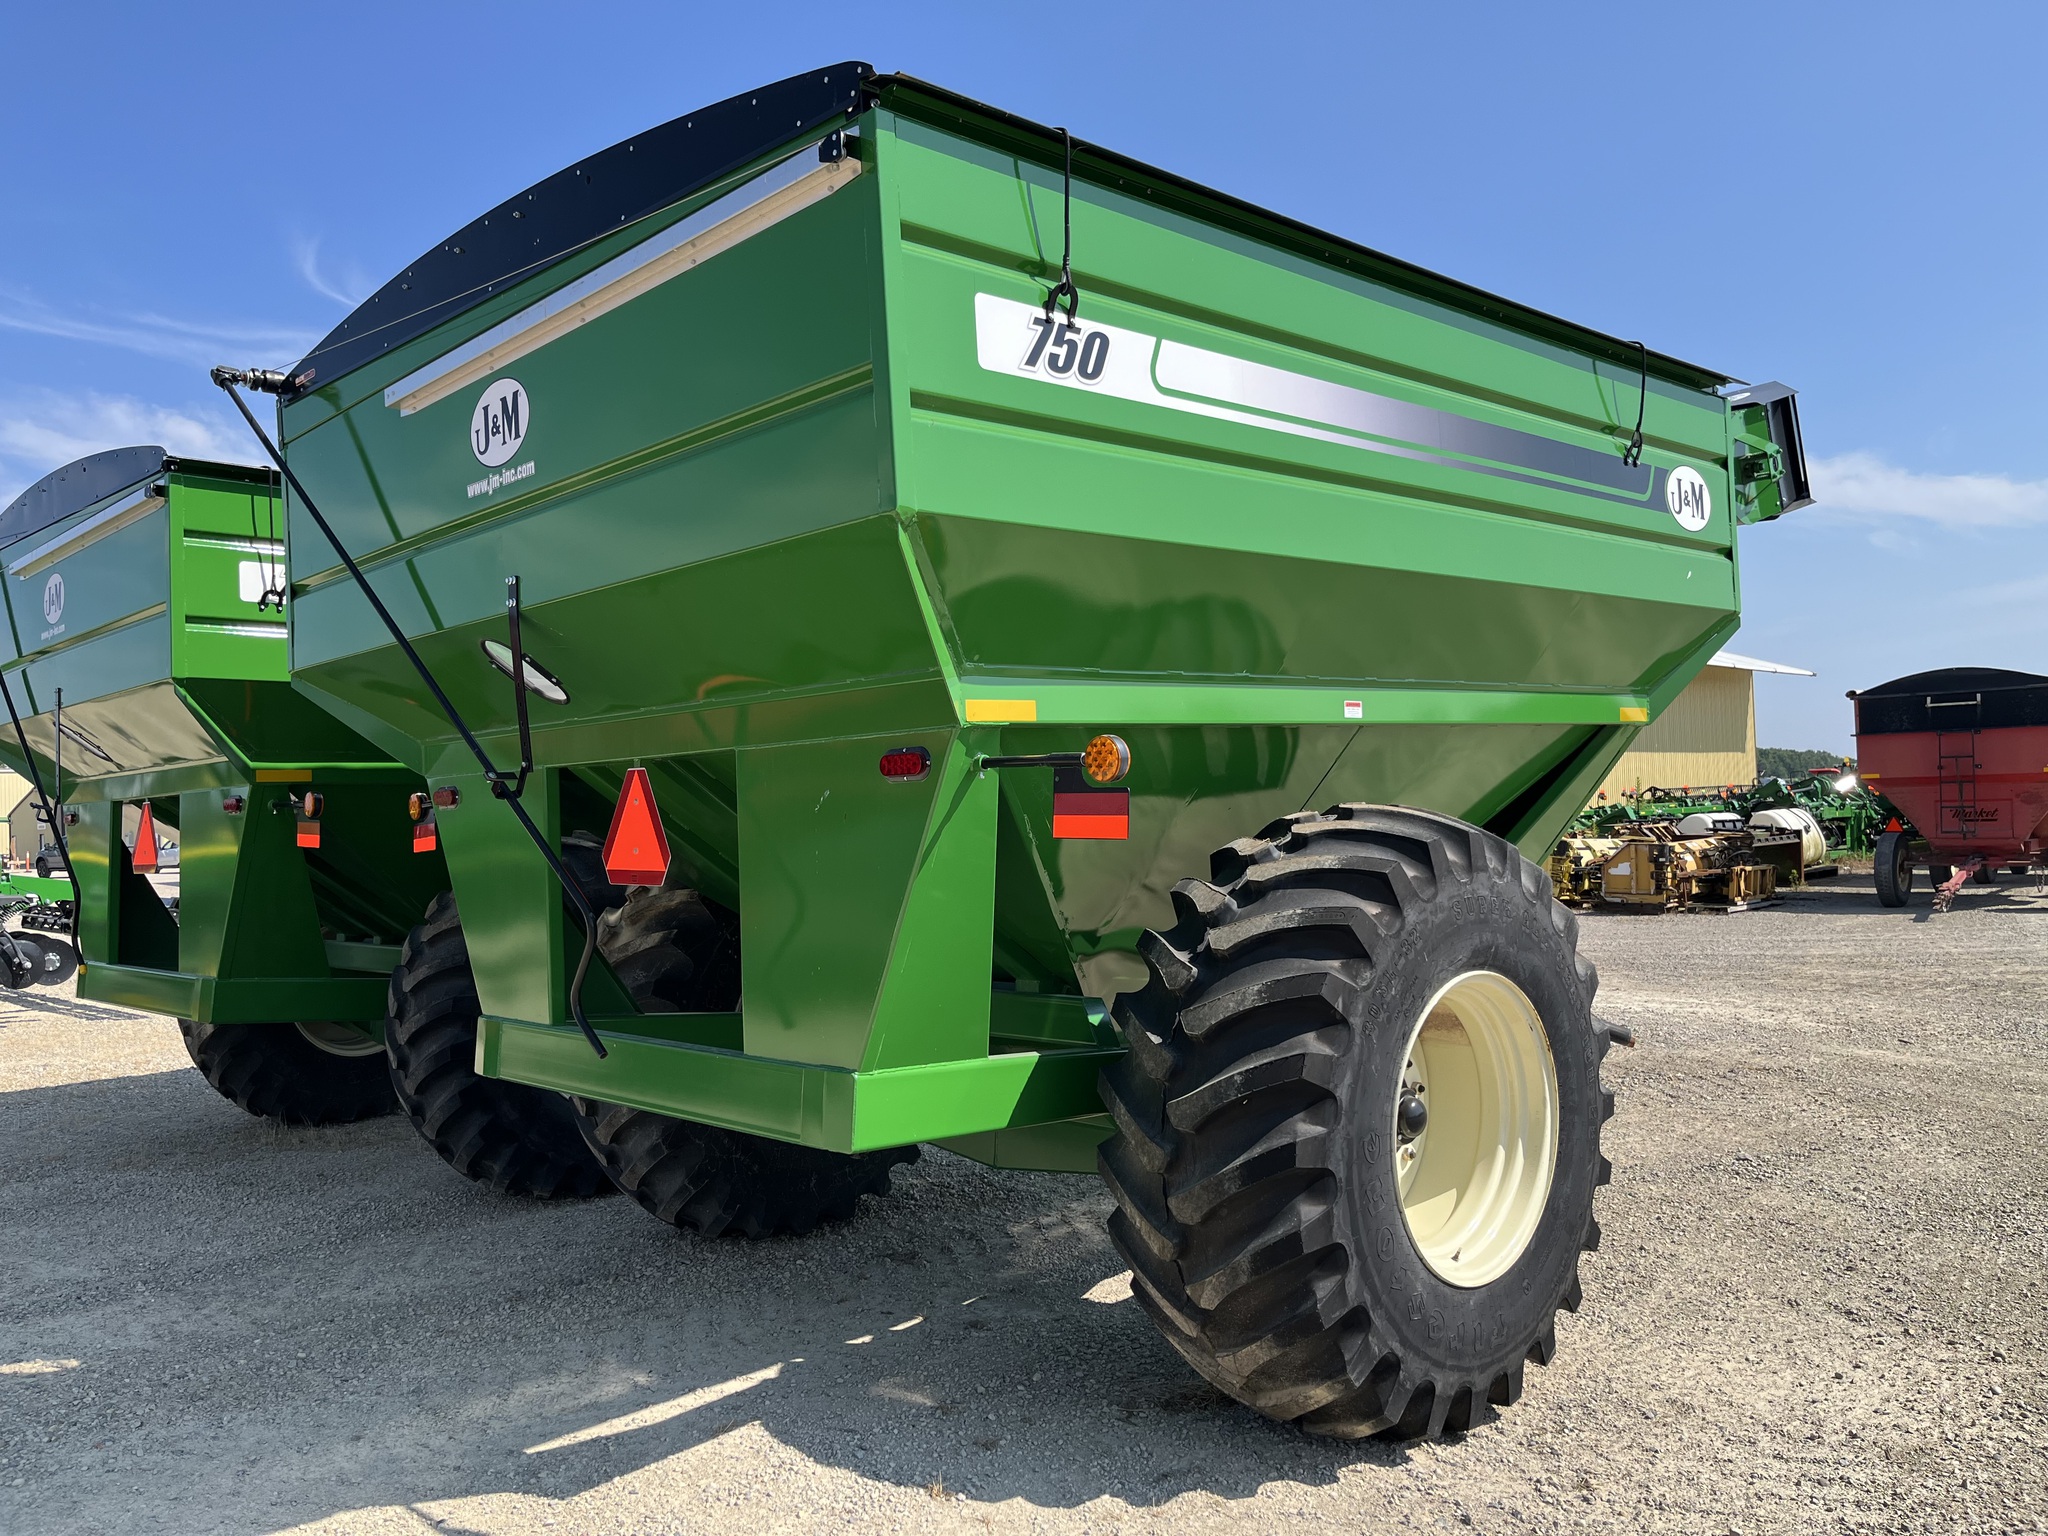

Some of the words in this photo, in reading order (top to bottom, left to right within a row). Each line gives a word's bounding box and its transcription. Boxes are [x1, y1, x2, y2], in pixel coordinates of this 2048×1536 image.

[1023, 316, 1111, 382] 750
[475, 389, 521, 456] J&M
[466, 460, 535, 498] www.jm-inc.com
[1671, 477, 1705, 520] J&M
